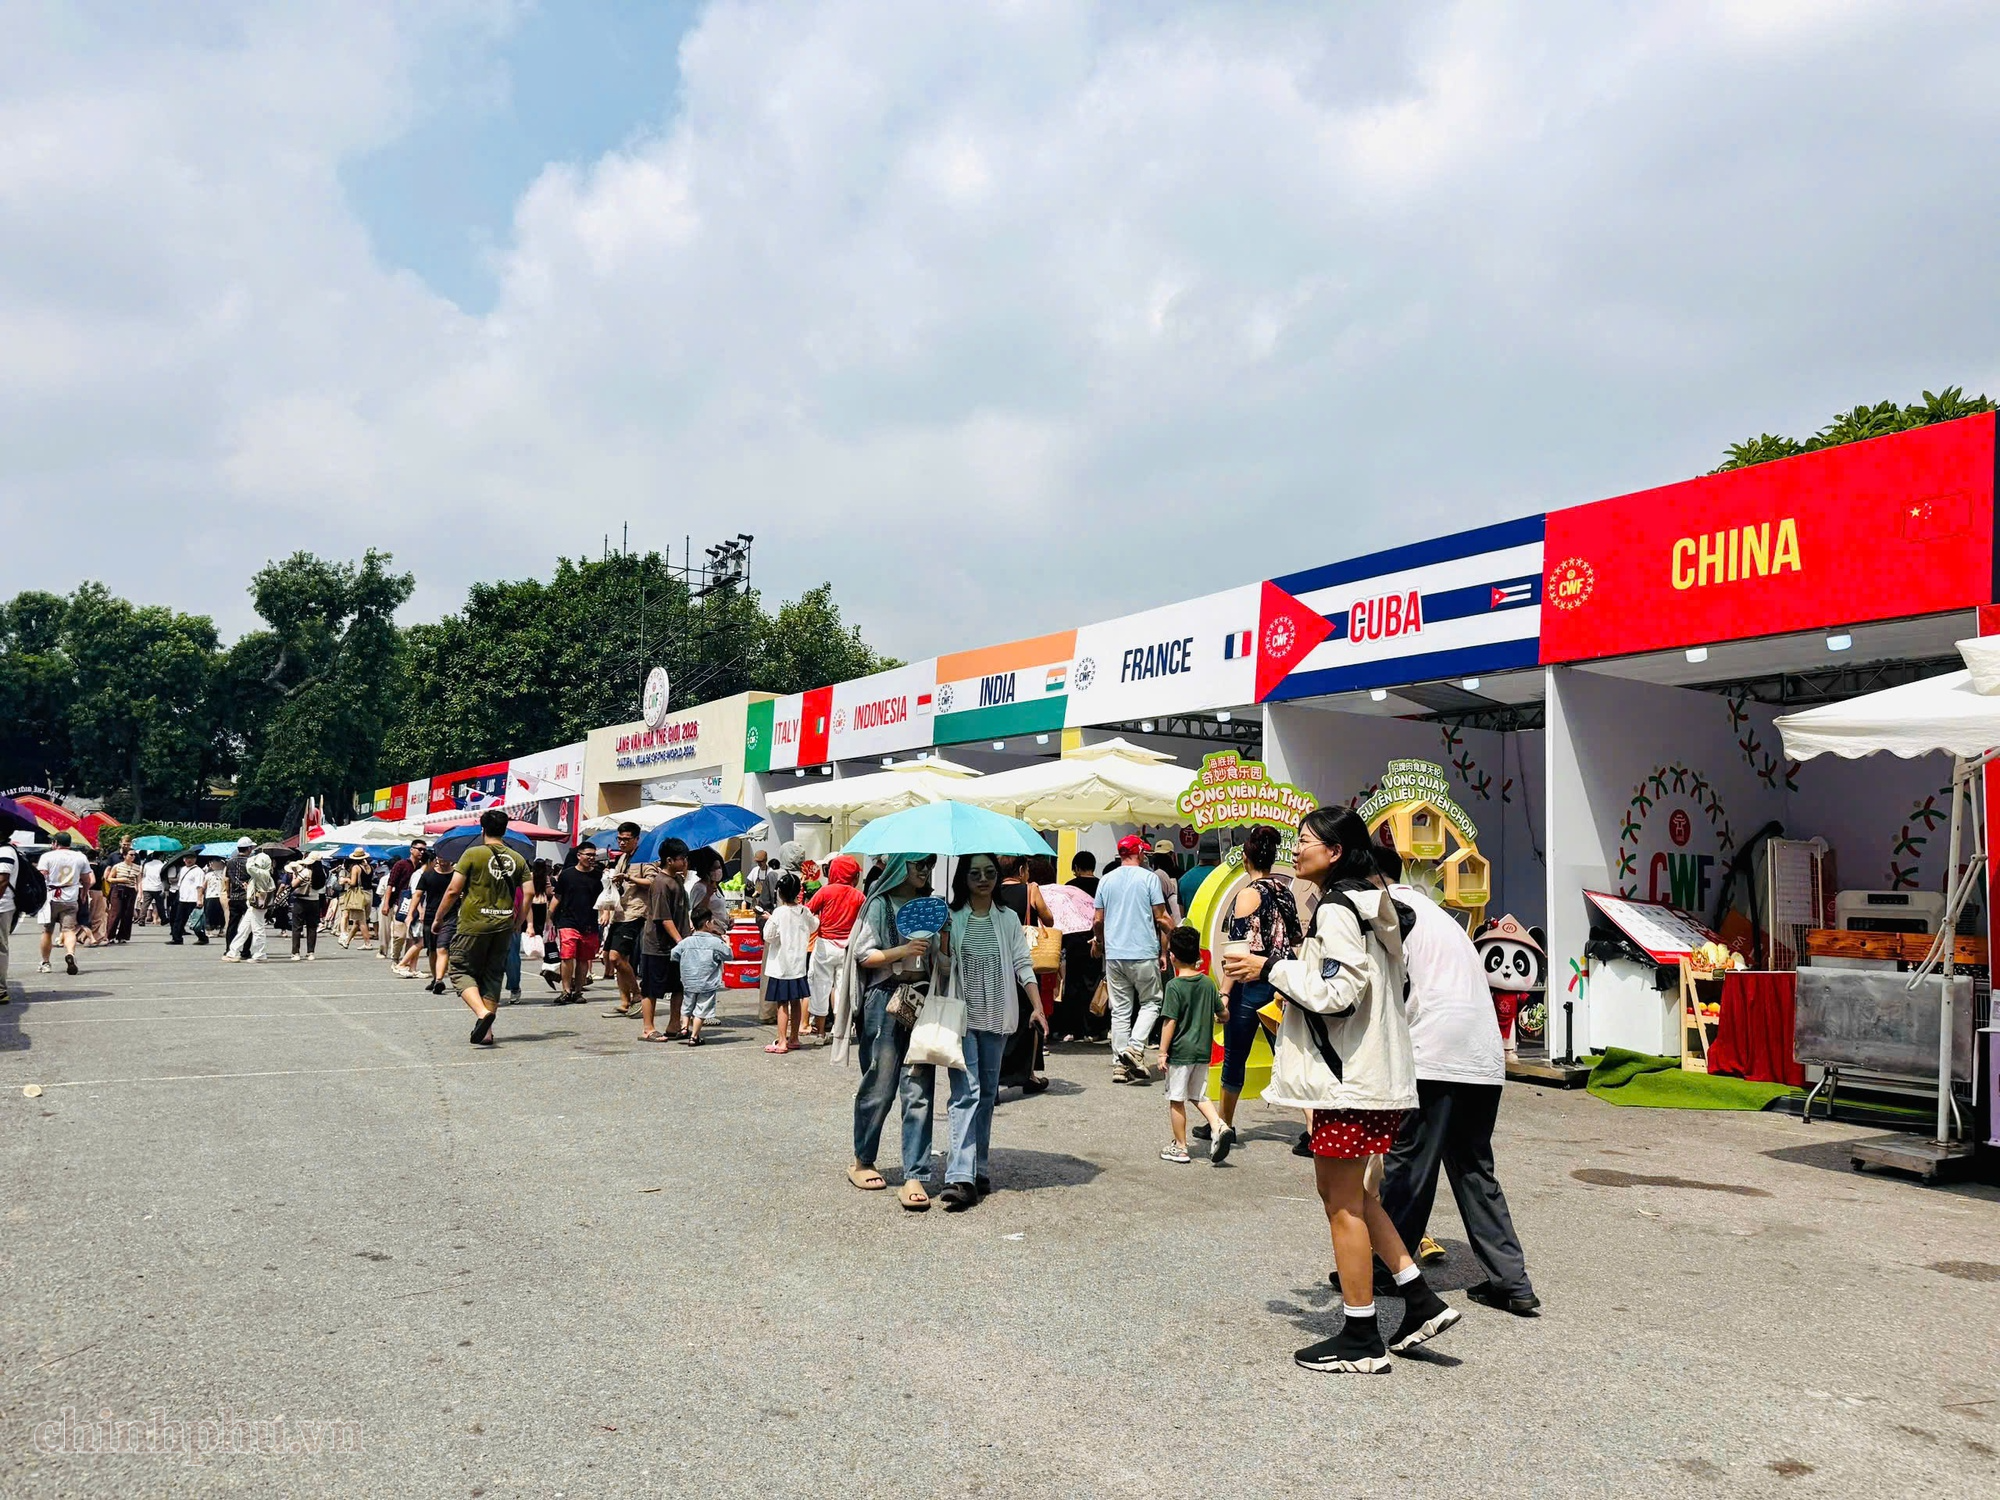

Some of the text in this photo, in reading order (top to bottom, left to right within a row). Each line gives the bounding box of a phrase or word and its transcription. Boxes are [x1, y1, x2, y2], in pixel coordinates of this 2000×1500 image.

[1671, 517, 1802, 590] CHINA
[1558, 578, 1585, 597] CWF
[1349, 589, 1422, 644] CUBA
[1271, 631, 1289, 648] CWF
[1120, 636, 1194, 683] FRANCE
[979, 672, 1016, 707] INDIA
[1078, 670, 1092, 683] CWF
[853, 695, 908, 731] INDONESIA
[681, 720, 699, 740] 2026
[774, 718, 799, 746] ITALY
[1201, 765, 1263, 786] 奇妙食乐园
[1417, 774, 1448, 794] QUAY
[1180, 784, 1226, 813] CÔNG
[1227, 781, 1257, 800] VIÊN
[1280, 787, 1316, 815] THỰC
[1194, 799, 1300, 829] KỲ DIỆU HAIDILA
[1360, 789, 1393, 822] GUYÊN
[1394, 785, 1415, 803] LIỆU
[1449, 806, 1477, 839] CHỌN
[1648, 851, 1715, 912] CWF
